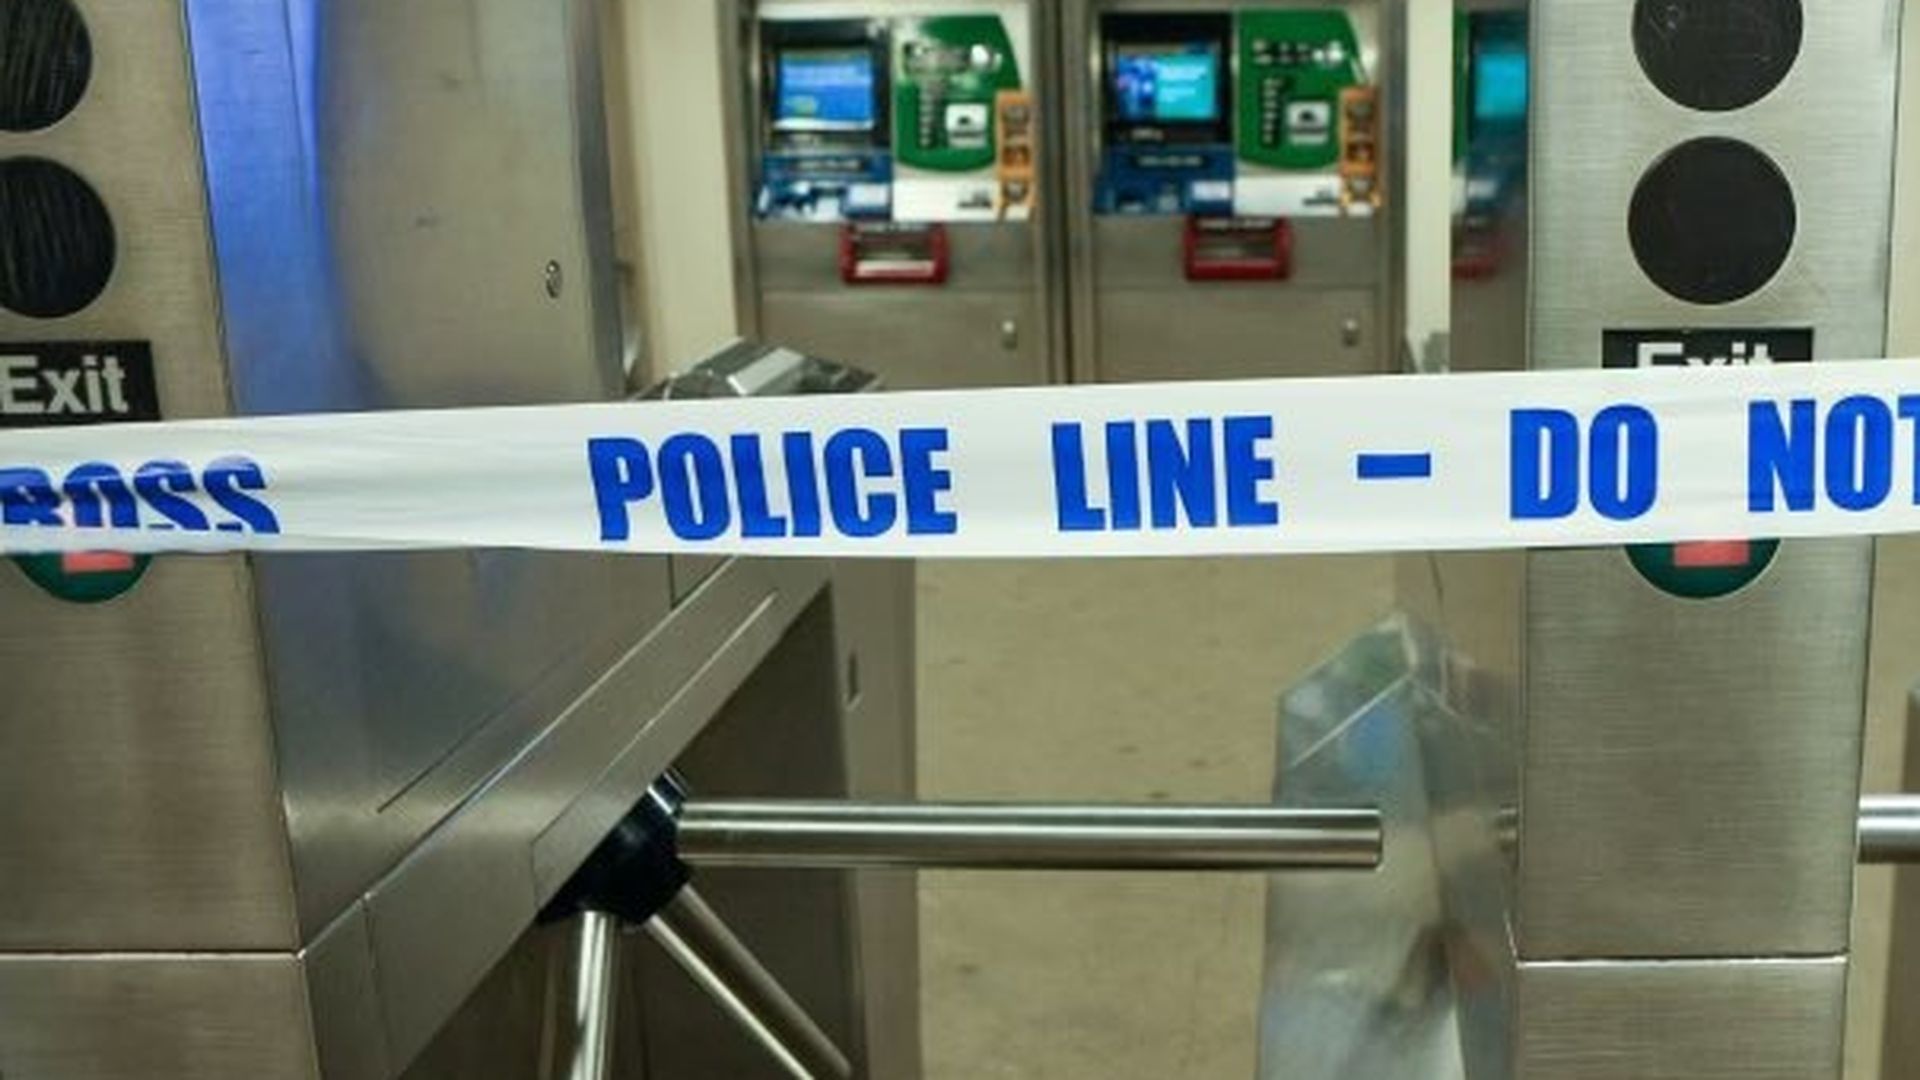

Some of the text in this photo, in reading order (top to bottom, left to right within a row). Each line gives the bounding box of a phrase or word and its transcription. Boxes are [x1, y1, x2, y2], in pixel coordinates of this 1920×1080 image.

[0, 355, 129, 414] Exit
[588, 427, 957, 541] POLICE
[1052, 415, 1279, 532] LINE
[1510, 404, 1658, 520] DO
